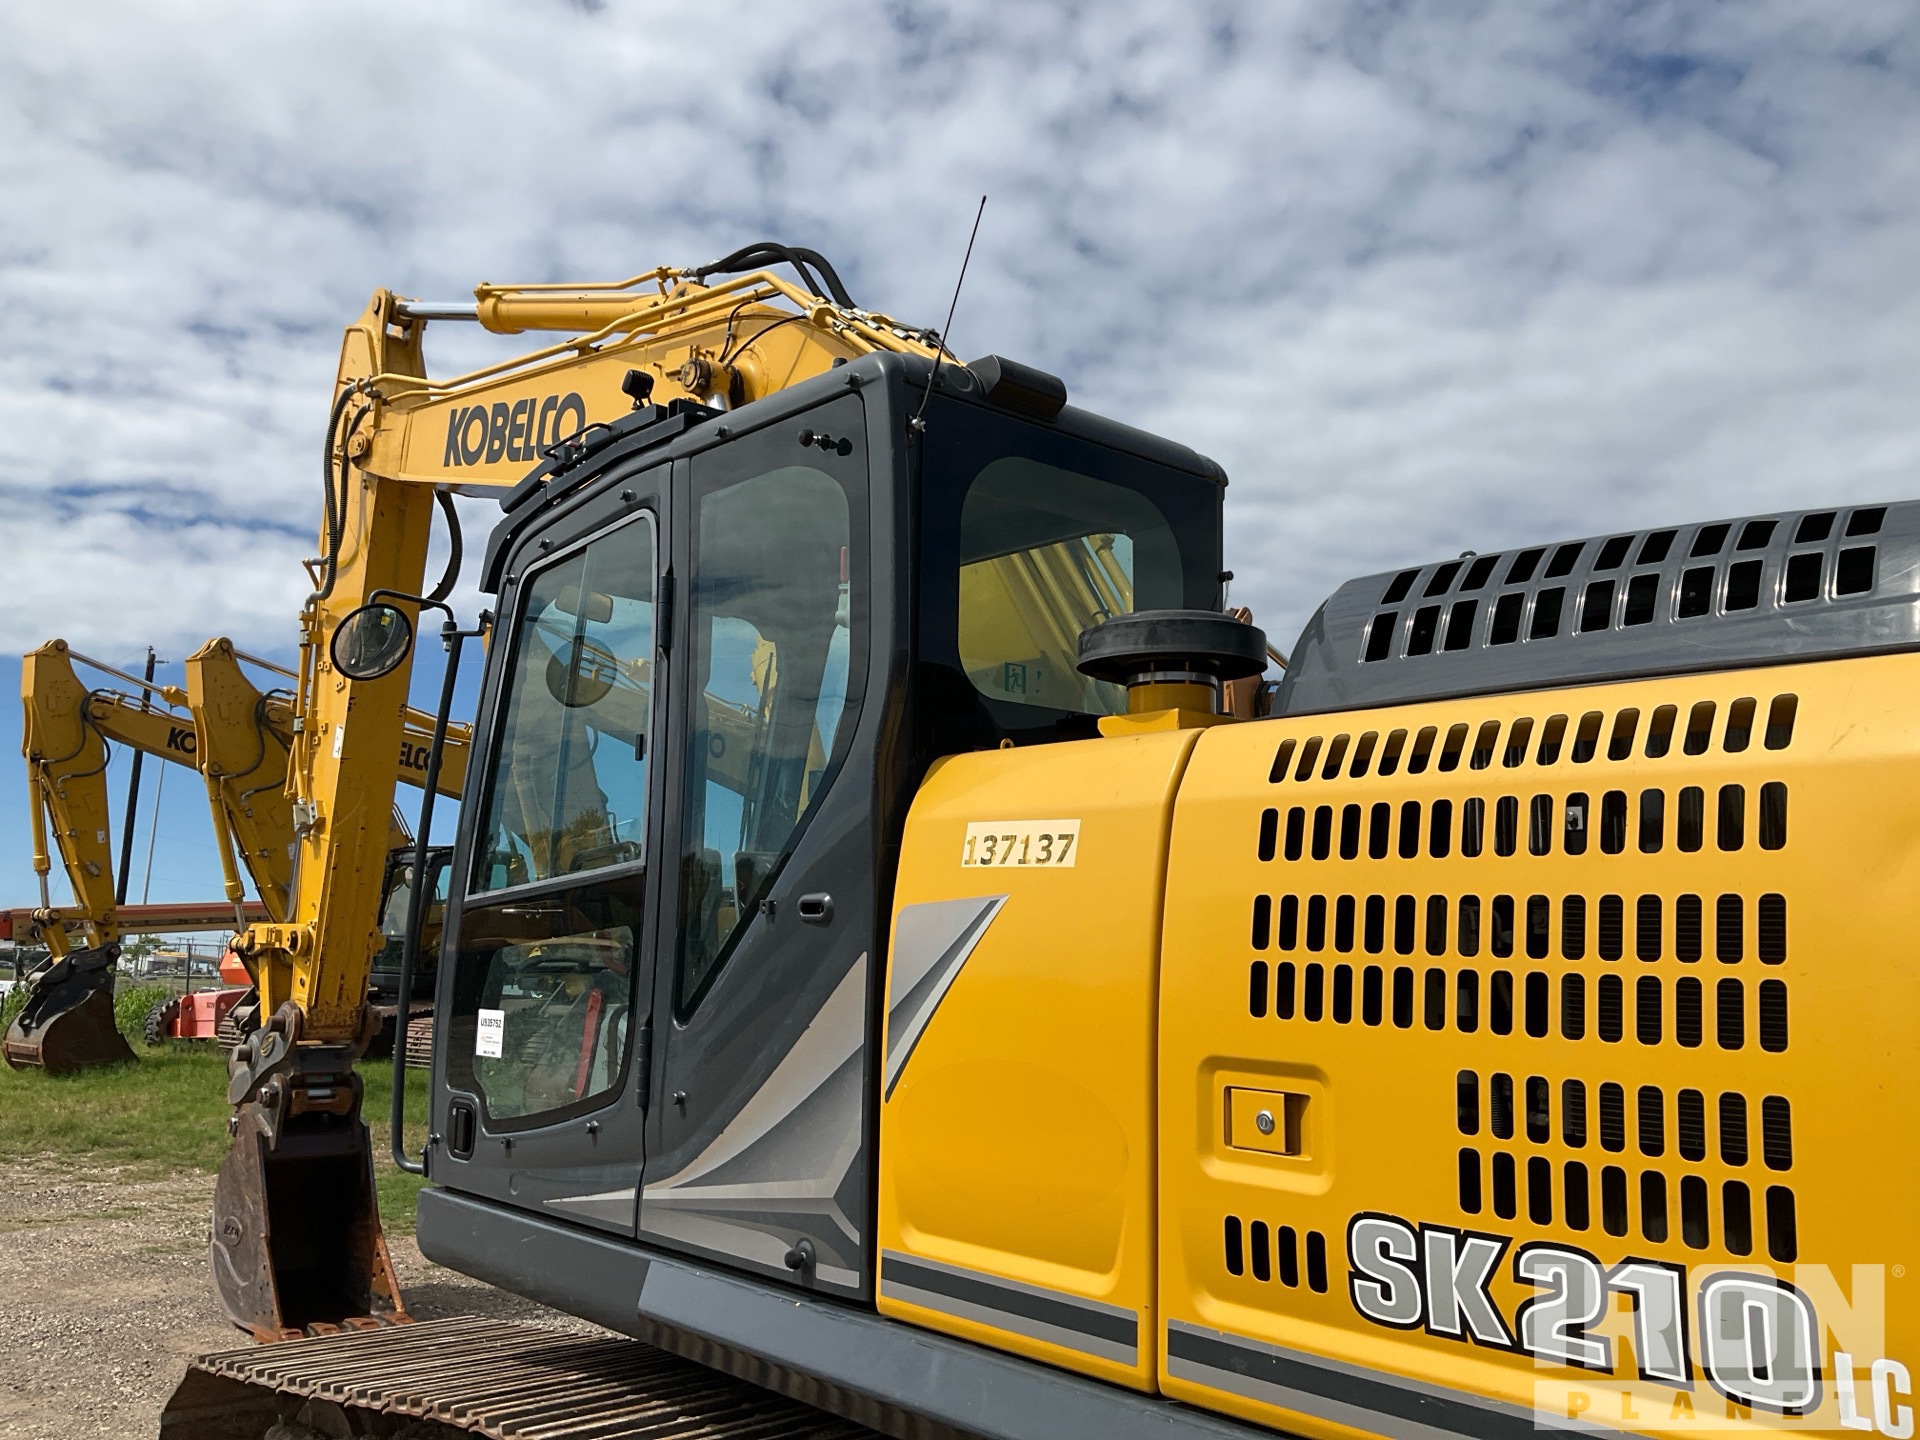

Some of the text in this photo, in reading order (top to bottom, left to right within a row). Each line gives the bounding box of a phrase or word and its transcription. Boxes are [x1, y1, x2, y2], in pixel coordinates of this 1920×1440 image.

[444, 392, 586, 467] KOBELCO
[964, 834, 1075, 866] 137137
[1347, 1211, 1824, 1416] SK210
[1834, 1350, 1914, 1439] LC
